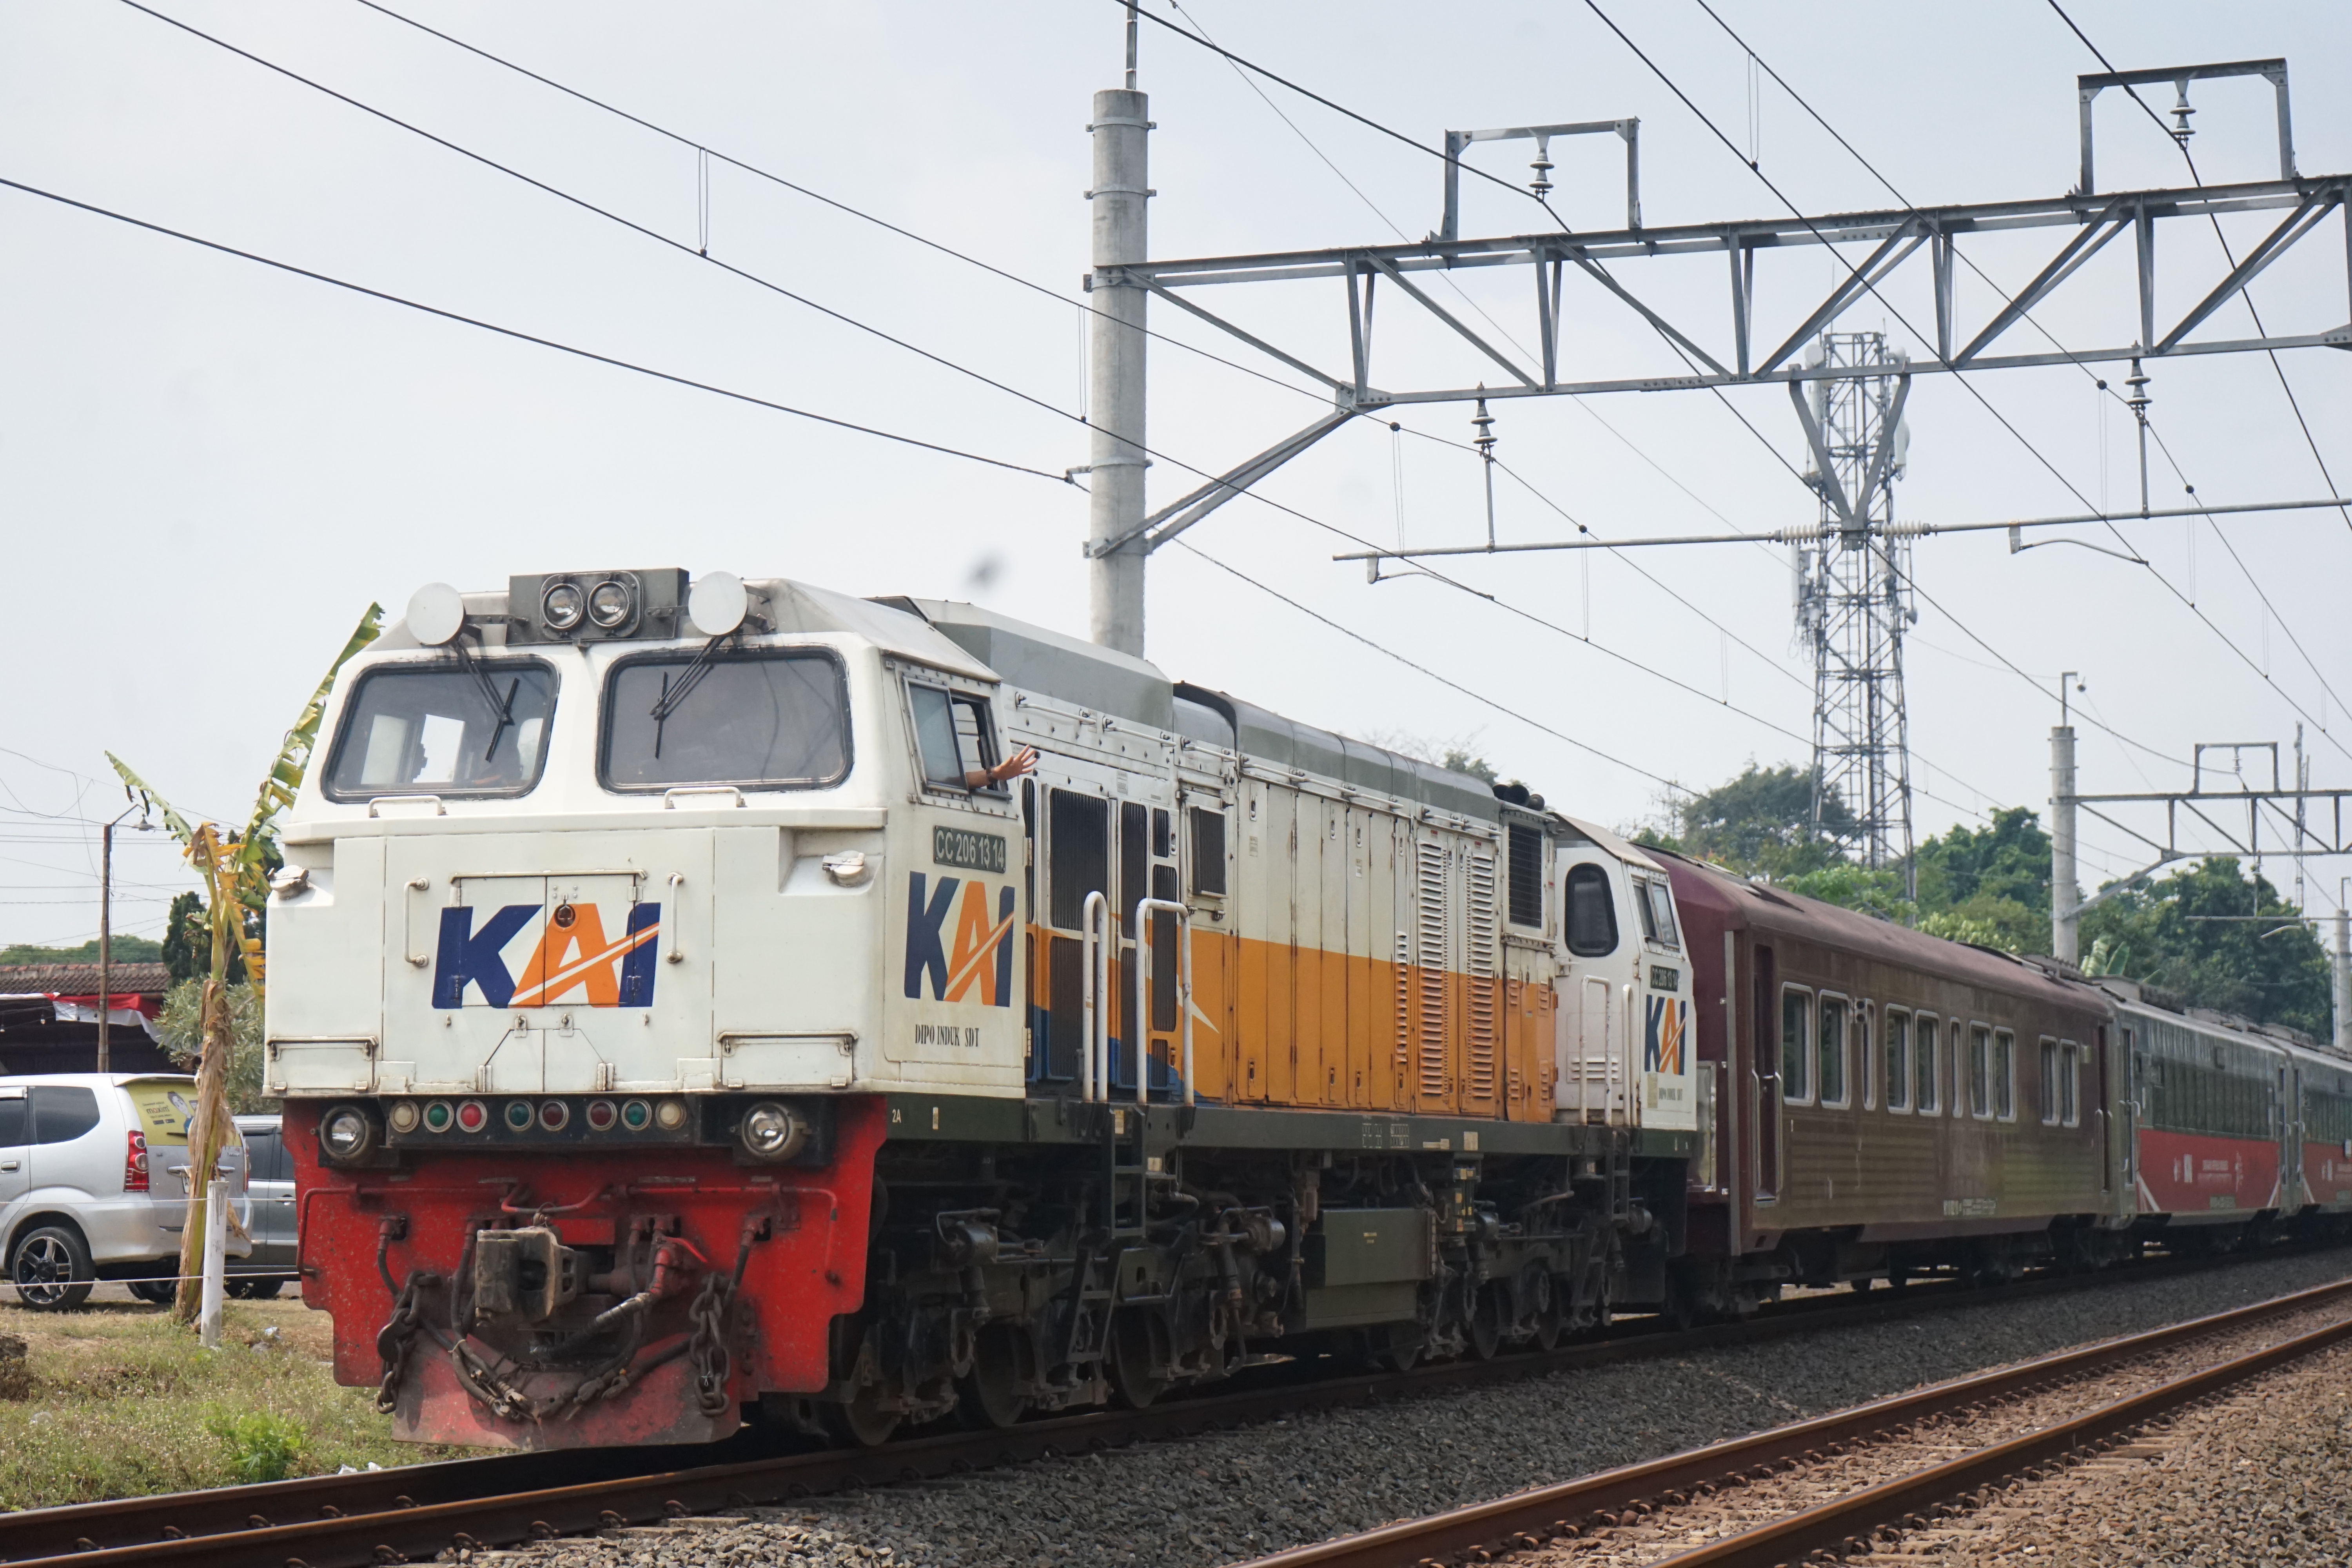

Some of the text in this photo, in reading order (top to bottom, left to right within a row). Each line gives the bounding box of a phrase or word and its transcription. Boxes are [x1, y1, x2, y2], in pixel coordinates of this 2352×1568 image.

[936, 830, 1004, 868] CC 206 13 14
[432, 902, 661, 1009] KAI
[904, 871, 1015, 1008] KAI
[915, 1024, 979, 1047] DIPO INDUK SDT
[1644, 994, 1686, 1076] KAI
[146, 1105, 170, 1114] maxim
[892, 1109, 901, 1123] 2A
